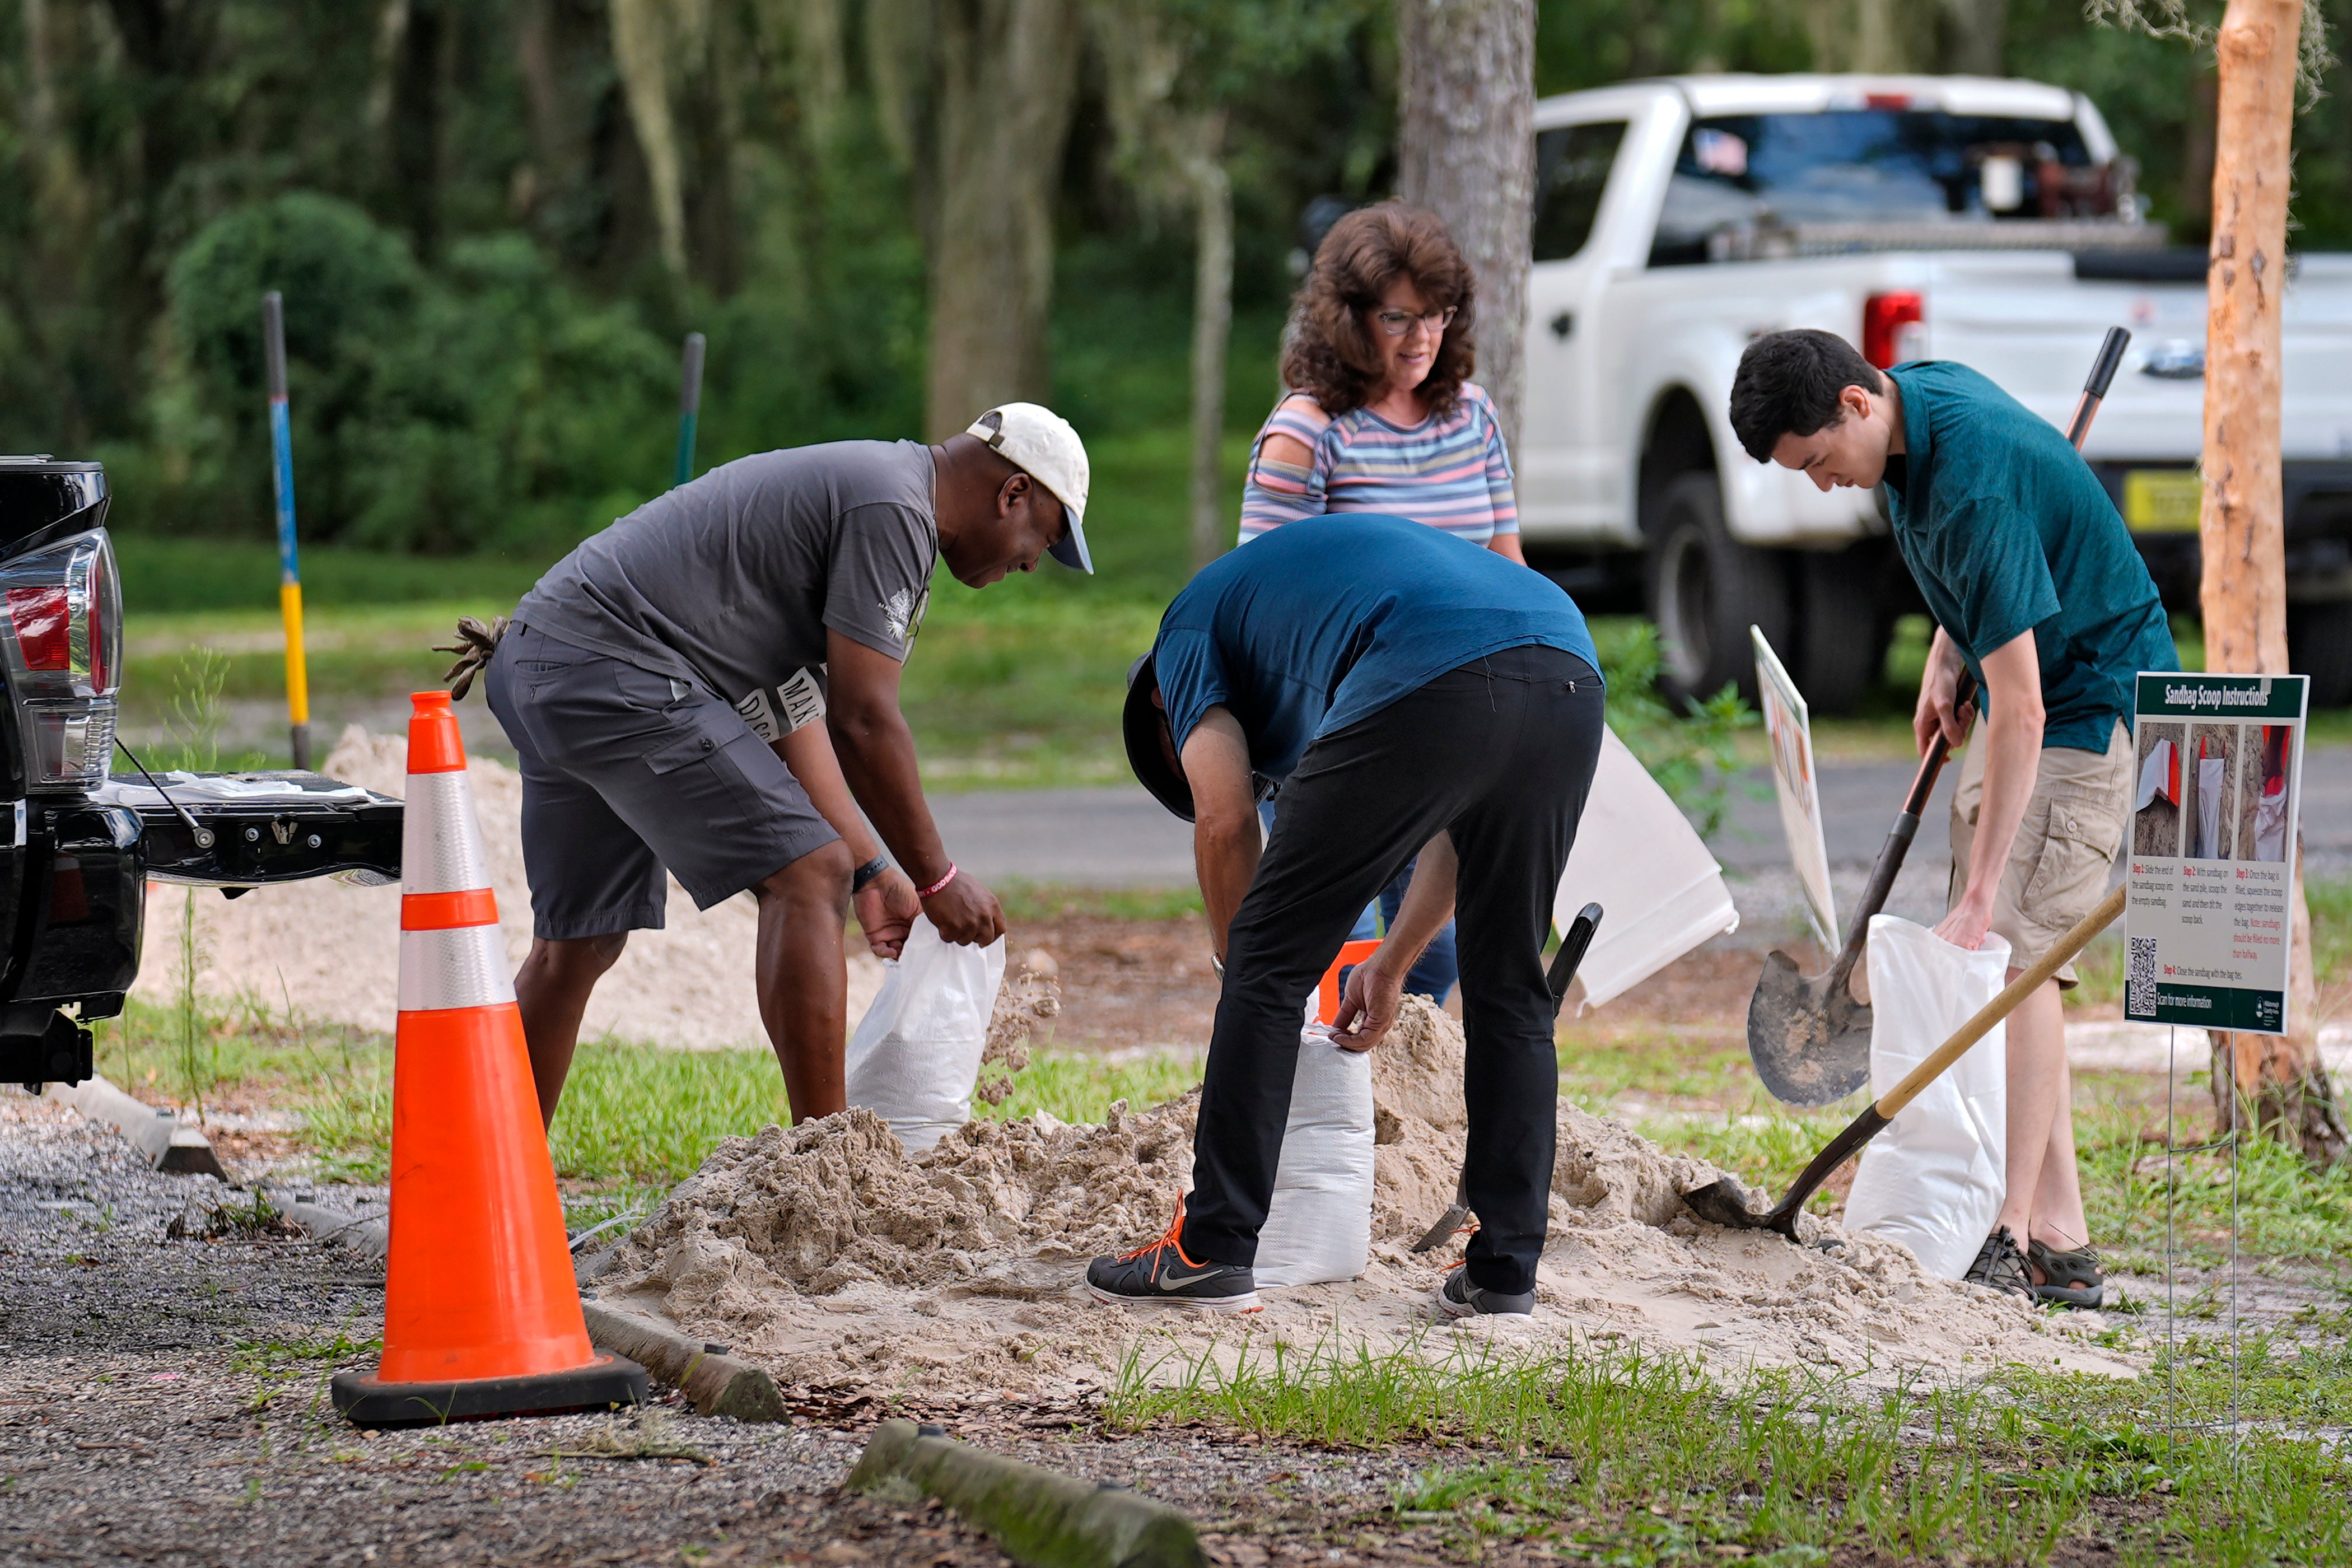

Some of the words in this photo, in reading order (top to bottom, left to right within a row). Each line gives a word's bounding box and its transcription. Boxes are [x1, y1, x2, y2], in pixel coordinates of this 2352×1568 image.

[2165, 684, 2197, 710] Sandbag
[2198, 685, 2222, 711] Scoop
[2222, 685, 2269, 706] Instructions
[2207, 867, 2223, 880] sandbag
[2139, 880, 2154, 892] sandbag
[2195, 968, 2210, 979] sandbag
[2157, 992, 2168, 1005] Scan
[2175, 996, 2187, 1007] more
[2187, 994, 2212, 1009] information
